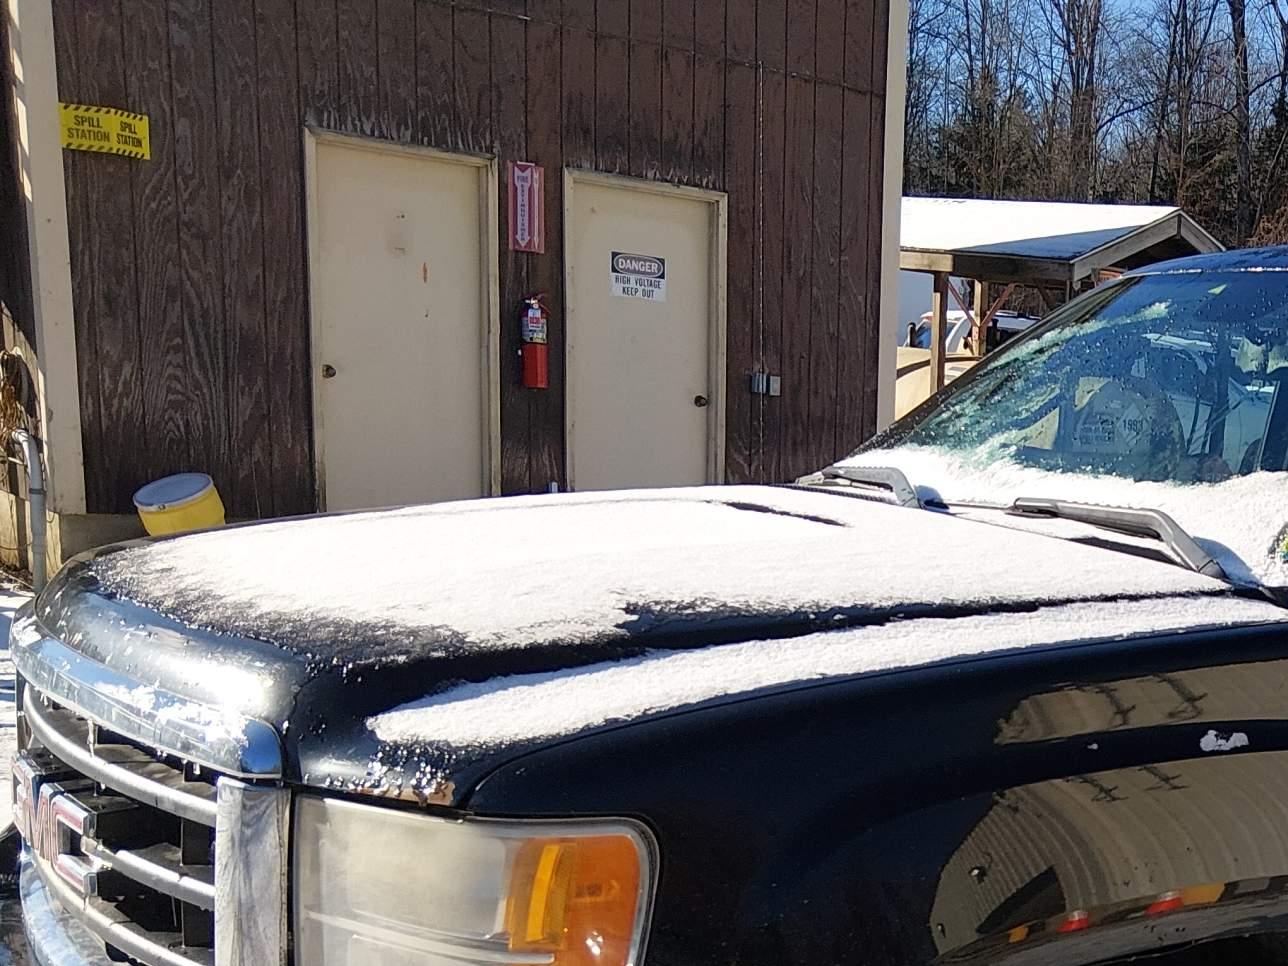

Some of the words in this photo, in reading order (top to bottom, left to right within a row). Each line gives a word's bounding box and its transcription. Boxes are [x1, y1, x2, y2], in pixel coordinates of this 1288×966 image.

[73, 115, 103, 129] SPILL
[119, 120, 138, 135] SPILL
[67, 127, 110, 143] STATION
[116, 133, 143, 149] STATION
[618, 258, 659, 273] DANGER
[615, 275, 631, 285] HIGH
[634, 277, 662, 289] VOLTAGE
[622, 286, 639, 297] KEEP
[641, 289, 655, 299] OUT
[11, 752, 97, 896] GMC
